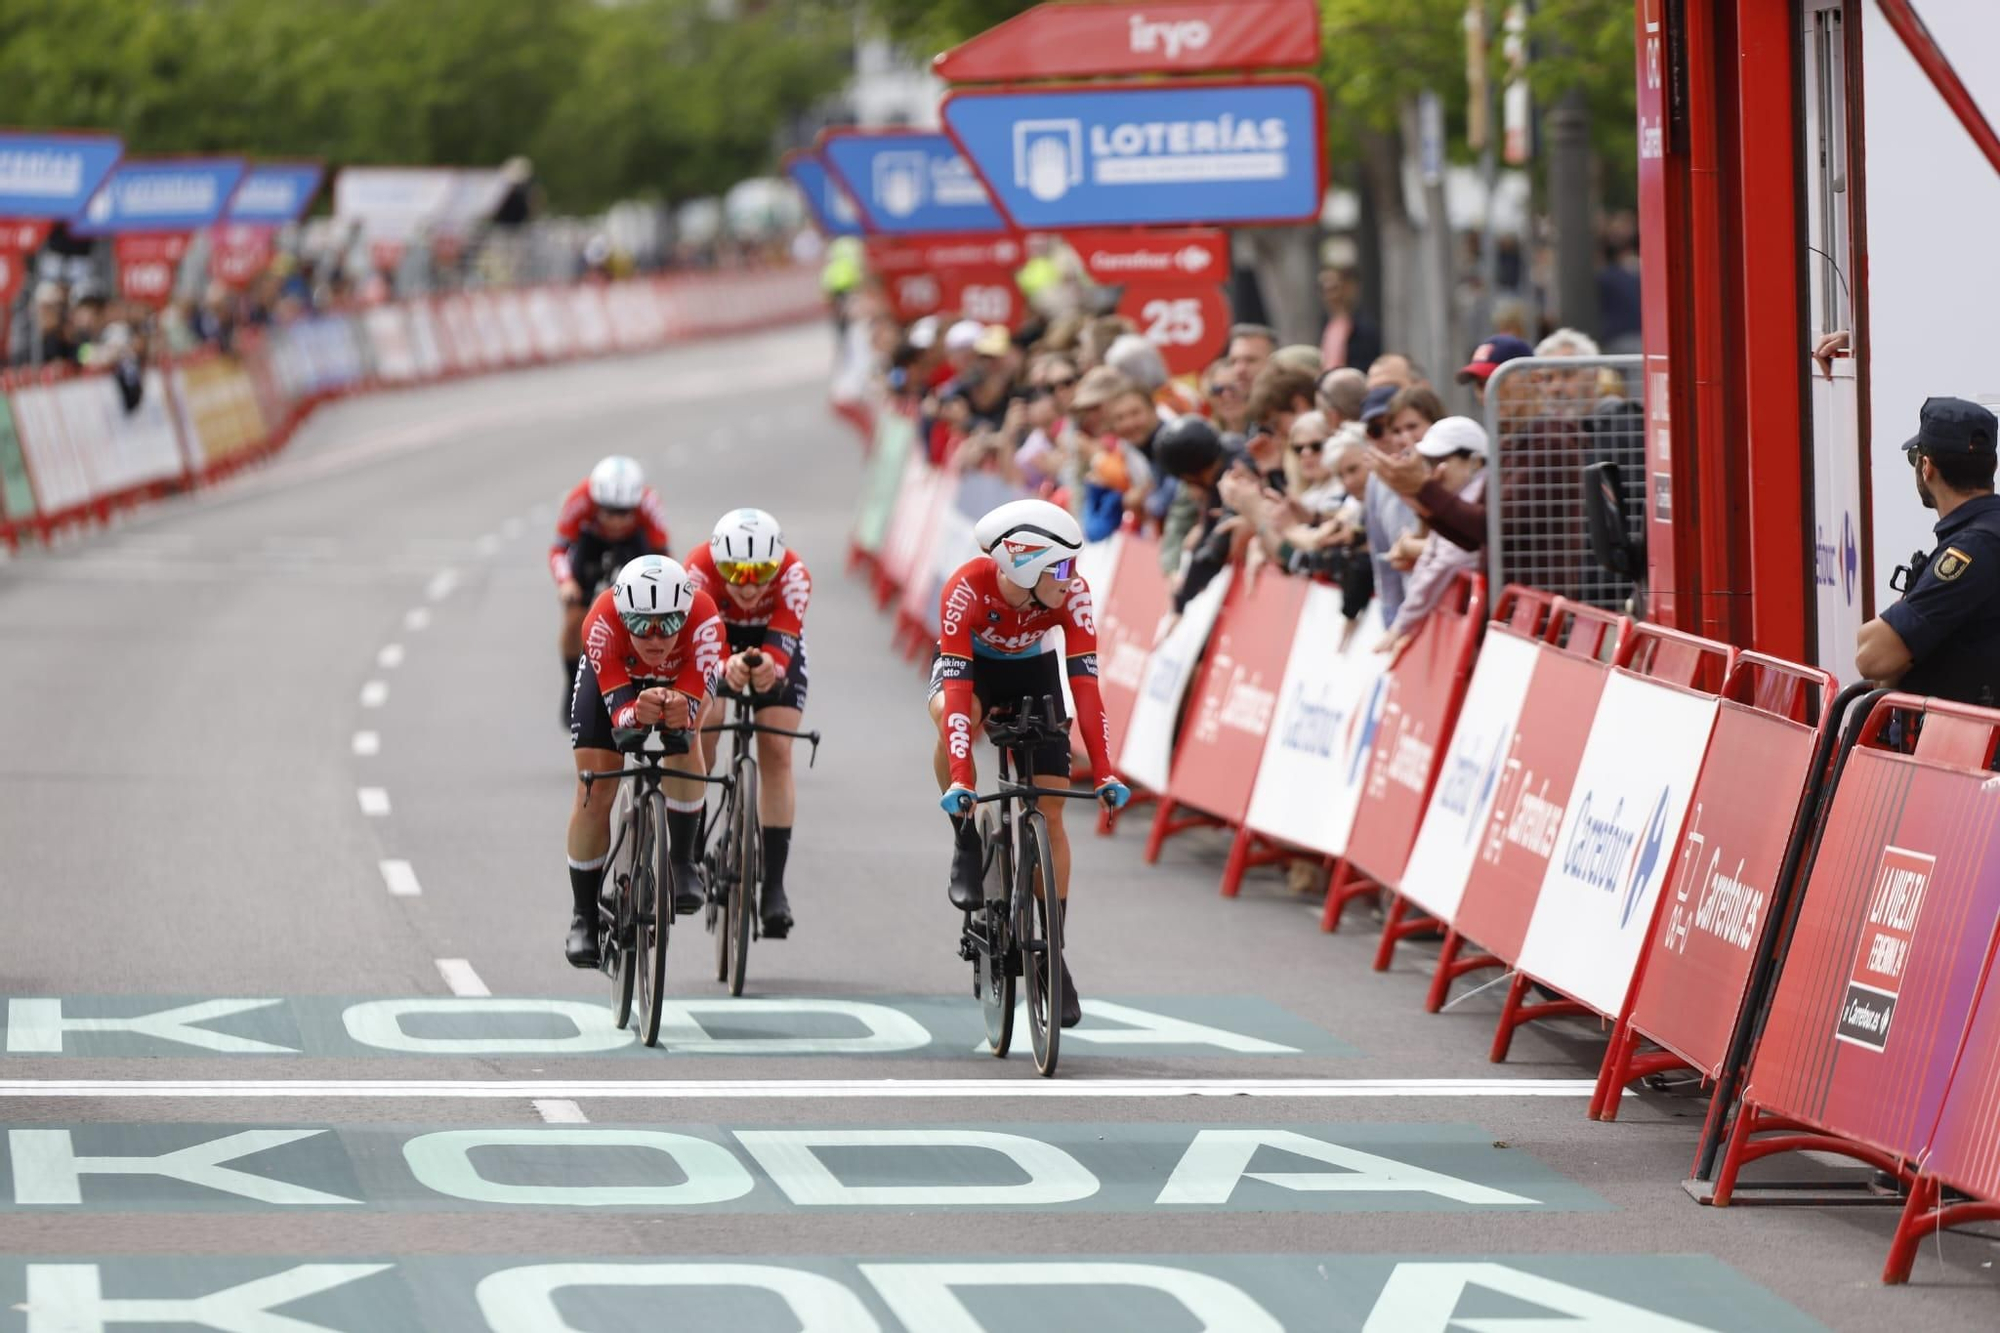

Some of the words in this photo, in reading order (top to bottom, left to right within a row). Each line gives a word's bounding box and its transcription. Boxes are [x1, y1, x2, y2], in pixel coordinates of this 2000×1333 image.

[1129, 14, 1209, 57] iryo
[1091, 114, 1288, 156] LOTERÍAS
[1141, 299, 1204, 345] 25
[943, 577, 977, 636] dstny
[586, 614, 615, 675] dstny
[947, 712, 971, 759] lotto
[1563, 790, 1635, 893] Carrefour
[1695, 846, 1763, 950] Carrefour.es
[1869, 866, 1897, 925] LA
[1887, 868, 1927, 932] VUELTA
[8, 1129, 1545, 1205] KODA
